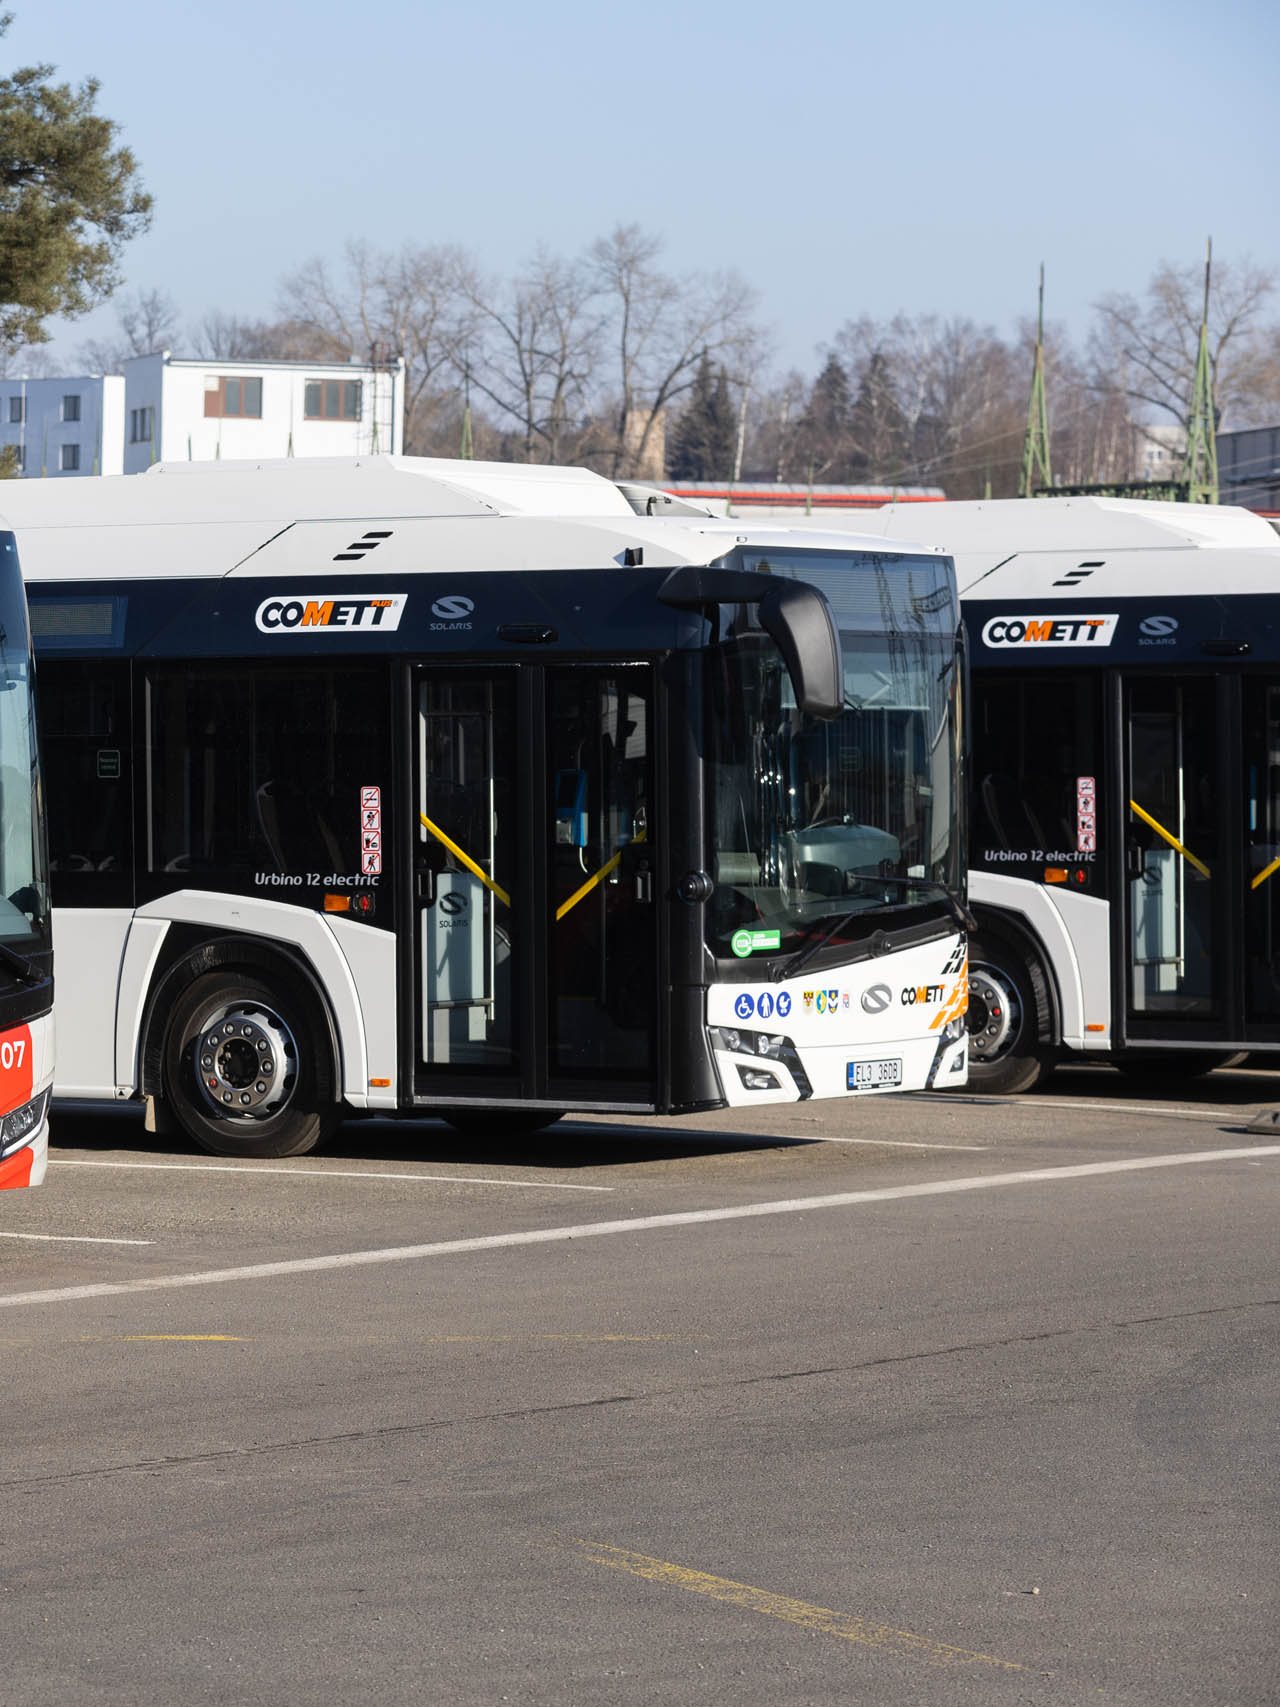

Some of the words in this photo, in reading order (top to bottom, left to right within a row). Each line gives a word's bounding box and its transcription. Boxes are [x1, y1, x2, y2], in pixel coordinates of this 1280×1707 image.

[261, 600, 387, 629] COMETT
[429, 622, 473, 631] SOLARIS
[988, 620, 1102, 643] COMETT
[1138, 638, 1177, 646] SOLARIS
[984, 850, 1028, 861] Urbino
[1031, 850, 1044, 861] 12
[1046, 850, 1096, 861] electric
[255, 872, 303, 886] Urbino
[306, 873, 321, 886] 12
[323, 873, 380, 886] electric
[901, 984, 946, 1006] COMETT
[856, 1065, 872, 1082] EL3
